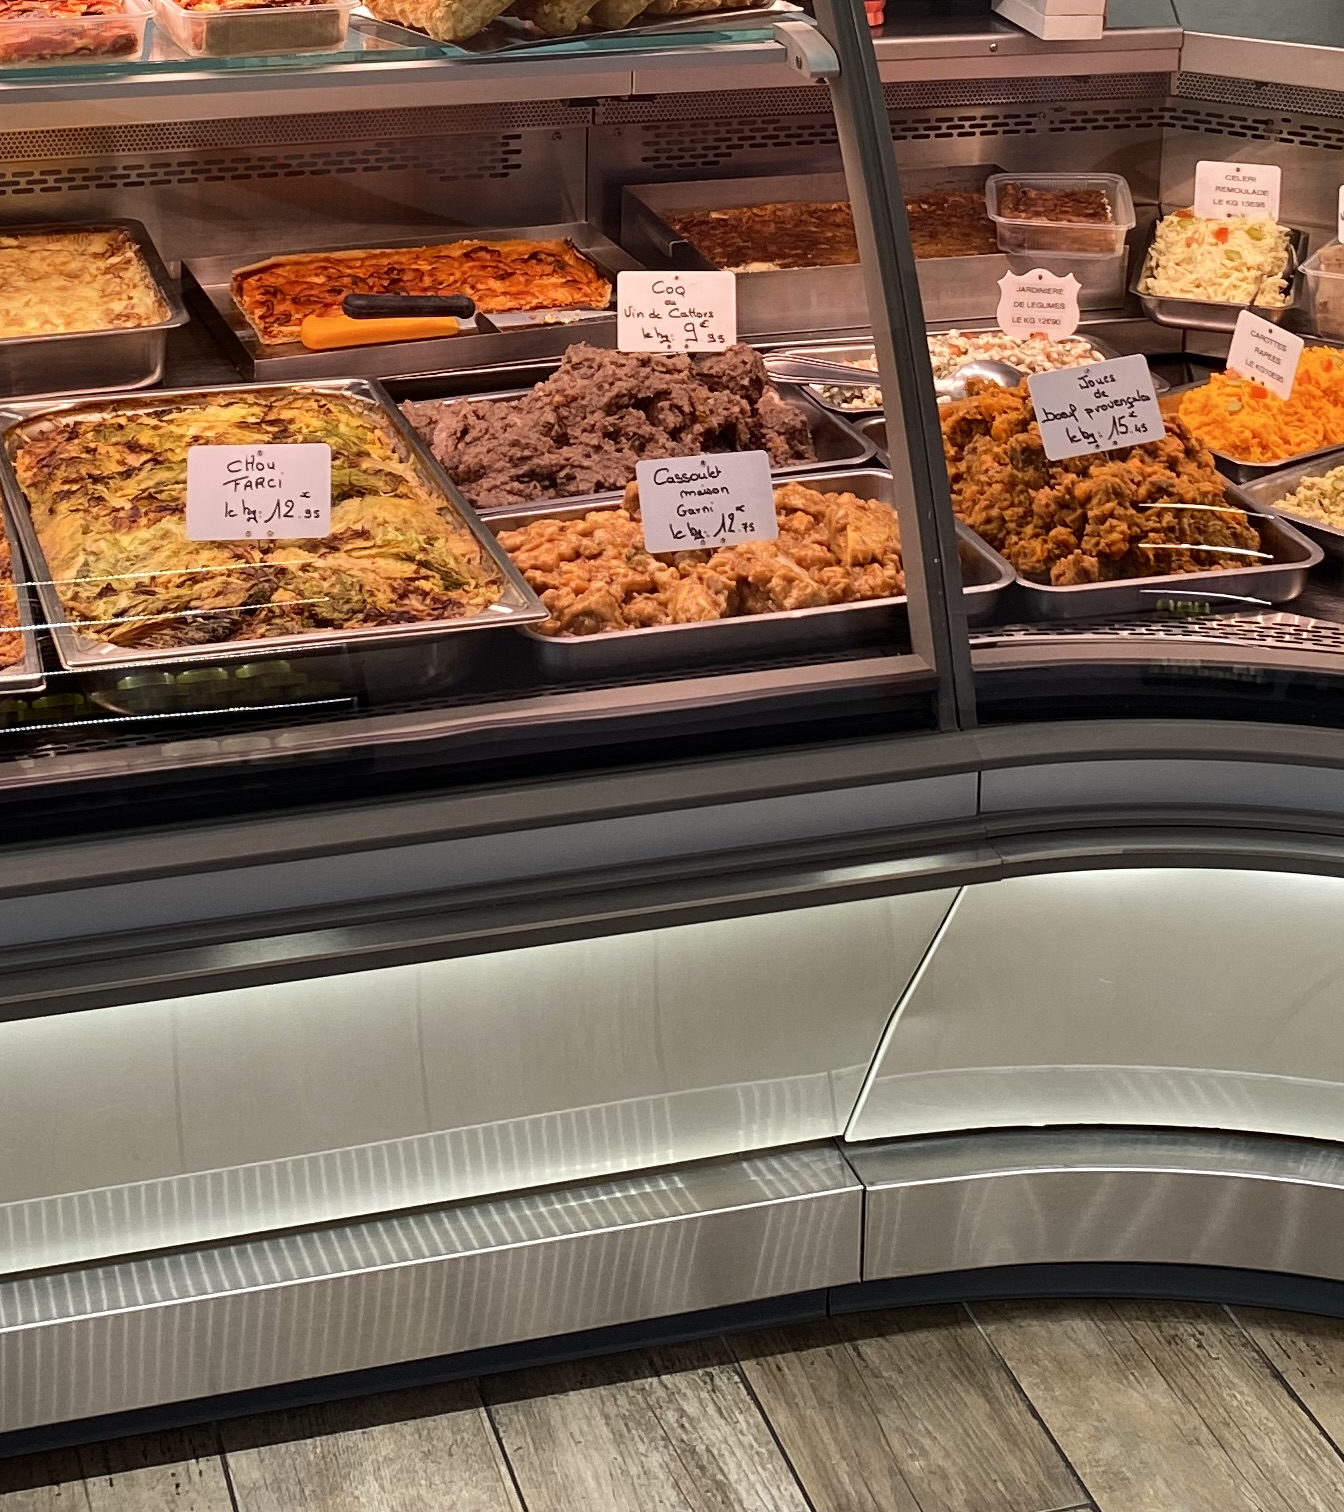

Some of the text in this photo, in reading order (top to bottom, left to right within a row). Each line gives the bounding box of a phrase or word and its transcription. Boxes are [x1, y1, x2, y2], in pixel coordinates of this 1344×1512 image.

[1215, 186, 1269, 196] REMOULADE
[1026, 301, 1066, 310] LEGUMES
[1250, 329, 1287, 352] CAROTTES
[1245, 359, 1255, 368] LE
[1254, 346, 1281, 366] RAPEES
[654, 465, 722, 486] Cassoulet
[680, 484, 730, 499] maison
